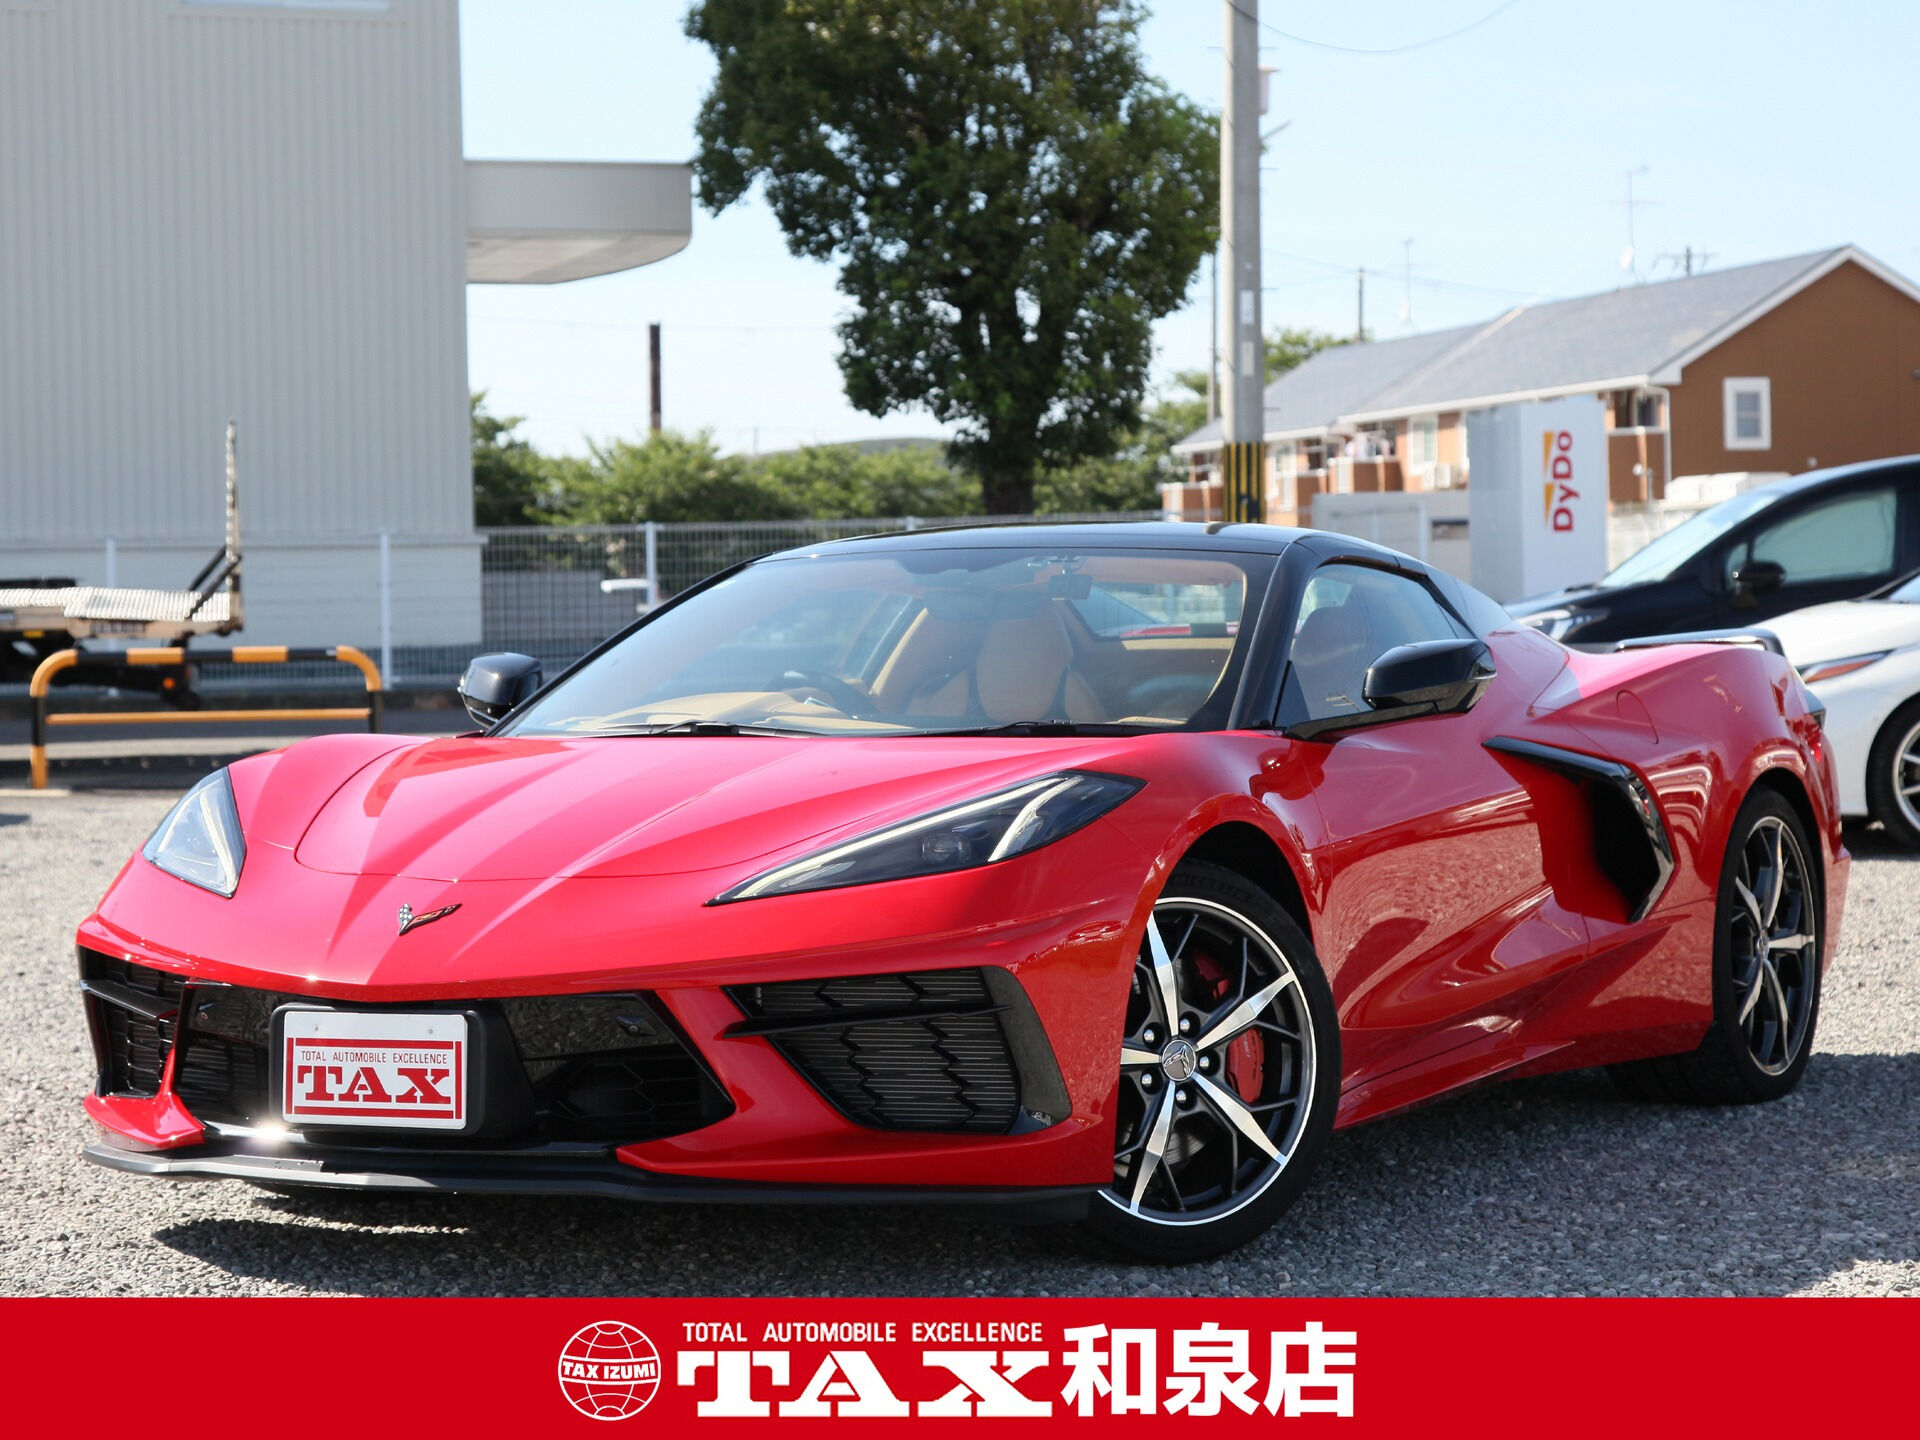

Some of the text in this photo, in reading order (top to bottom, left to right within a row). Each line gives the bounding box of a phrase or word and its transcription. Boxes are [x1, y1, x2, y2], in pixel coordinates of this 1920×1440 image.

[1552, 431, 1580, 532] DyDo
[301, 1050, 448, 1065] TOTAL AUTOMOBILE EXCELLENCE
[297, 1065, 451, 1105] TAX
